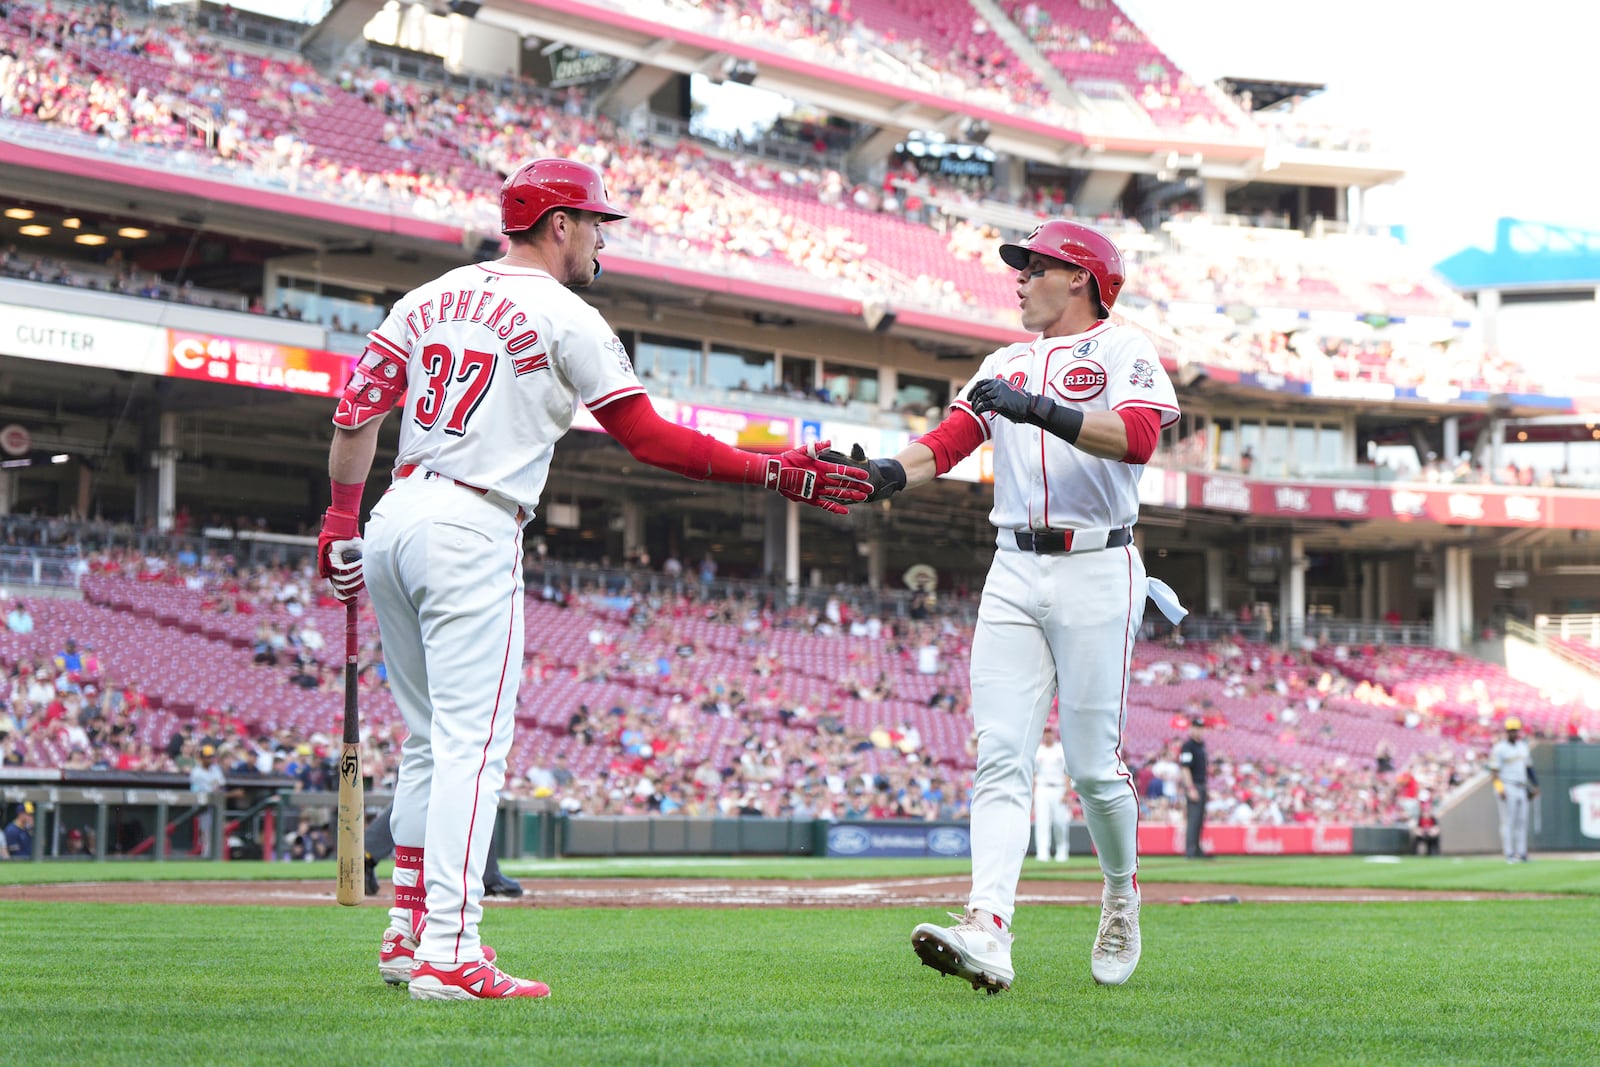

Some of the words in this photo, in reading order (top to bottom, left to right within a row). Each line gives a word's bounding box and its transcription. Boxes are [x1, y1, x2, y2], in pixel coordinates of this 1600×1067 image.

[16, 325, 94, 351] CUTTER
[1081, 342, 1092, 356] 4
[1064, 373, 1105, 386] REDS
[414, 343, 498, 438] 37
